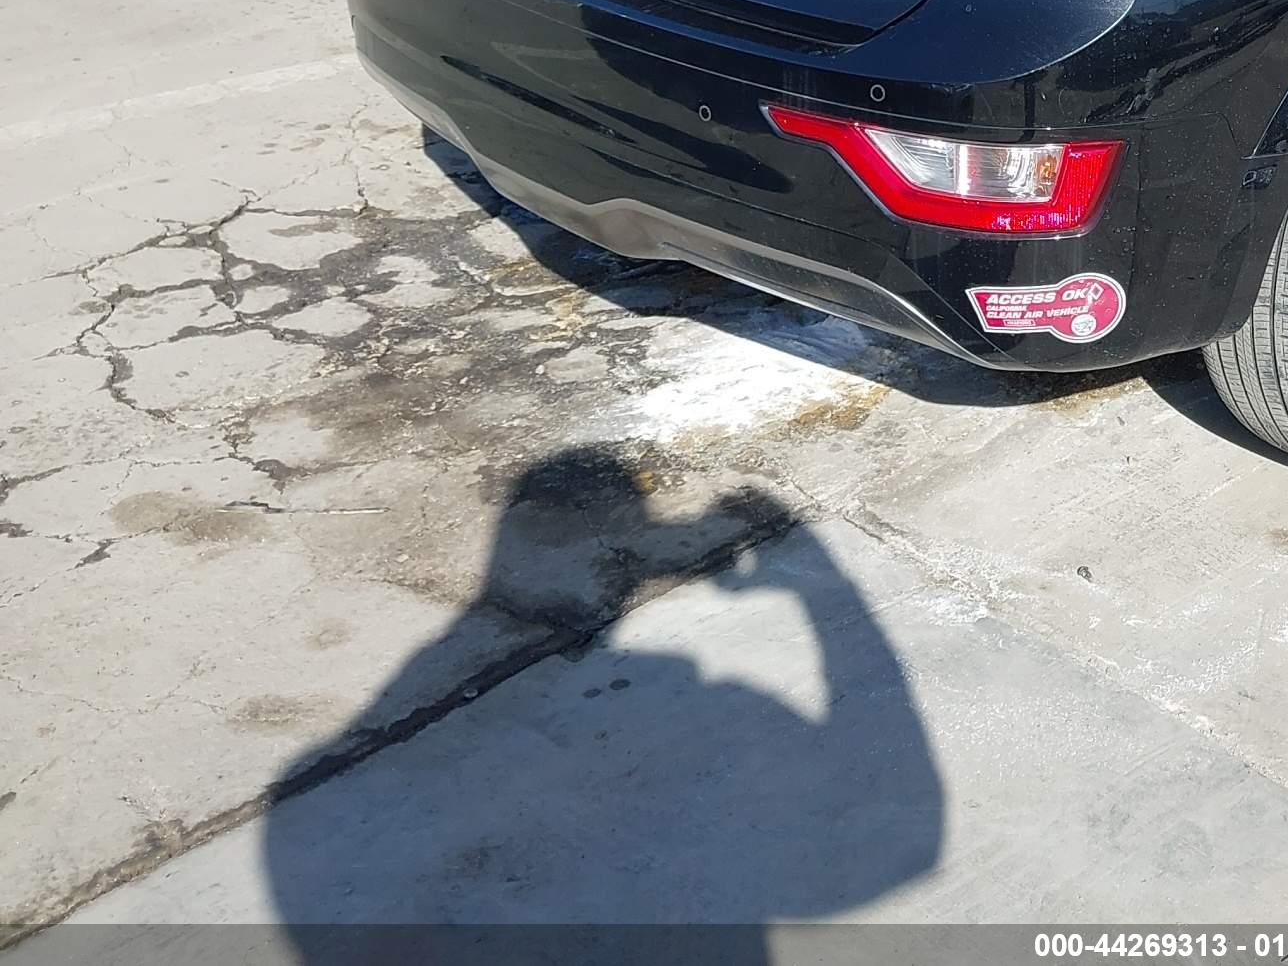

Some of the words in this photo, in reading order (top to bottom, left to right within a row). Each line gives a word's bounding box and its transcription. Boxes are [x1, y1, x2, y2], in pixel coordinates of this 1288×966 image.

[986, 293, 1056, 305] ACCESS
[1062, 288, 1088, 300] OK
[986, 311, 1021, 319] CLEAN
[1024, 311, 1043, 319] AIR
[1046, 305, 1090, 318] VEHICLE
